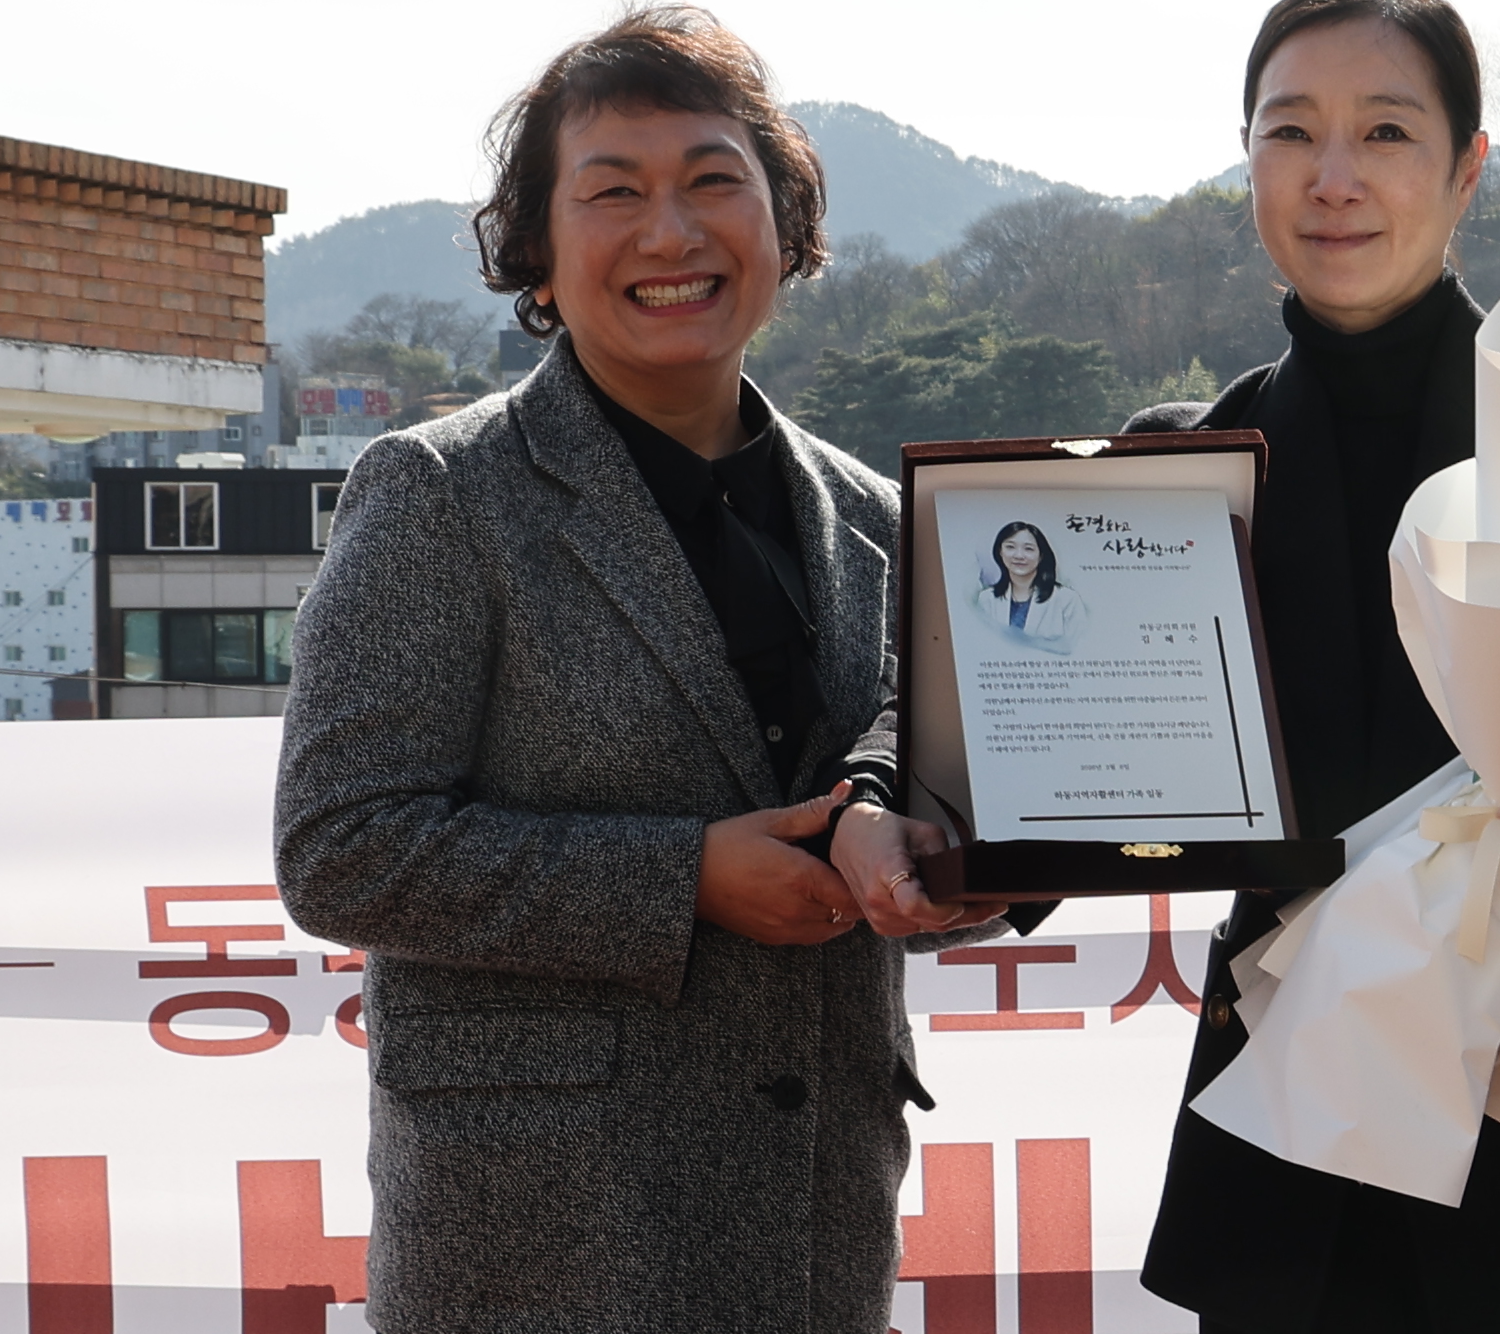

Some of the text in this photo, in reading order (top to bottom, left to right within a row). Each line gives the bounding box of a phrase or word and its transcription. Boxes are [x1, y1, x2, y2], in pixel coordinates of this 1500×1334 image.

[1065, 513, 1132, 534] 존경하고
[1102, 536, 1188, 559] 사랑합니다
[1139, 622, 1197, 632] 하동군의회 의원
[1054, 788, 1163, 801] 하동지역자활센터 가족 일동
